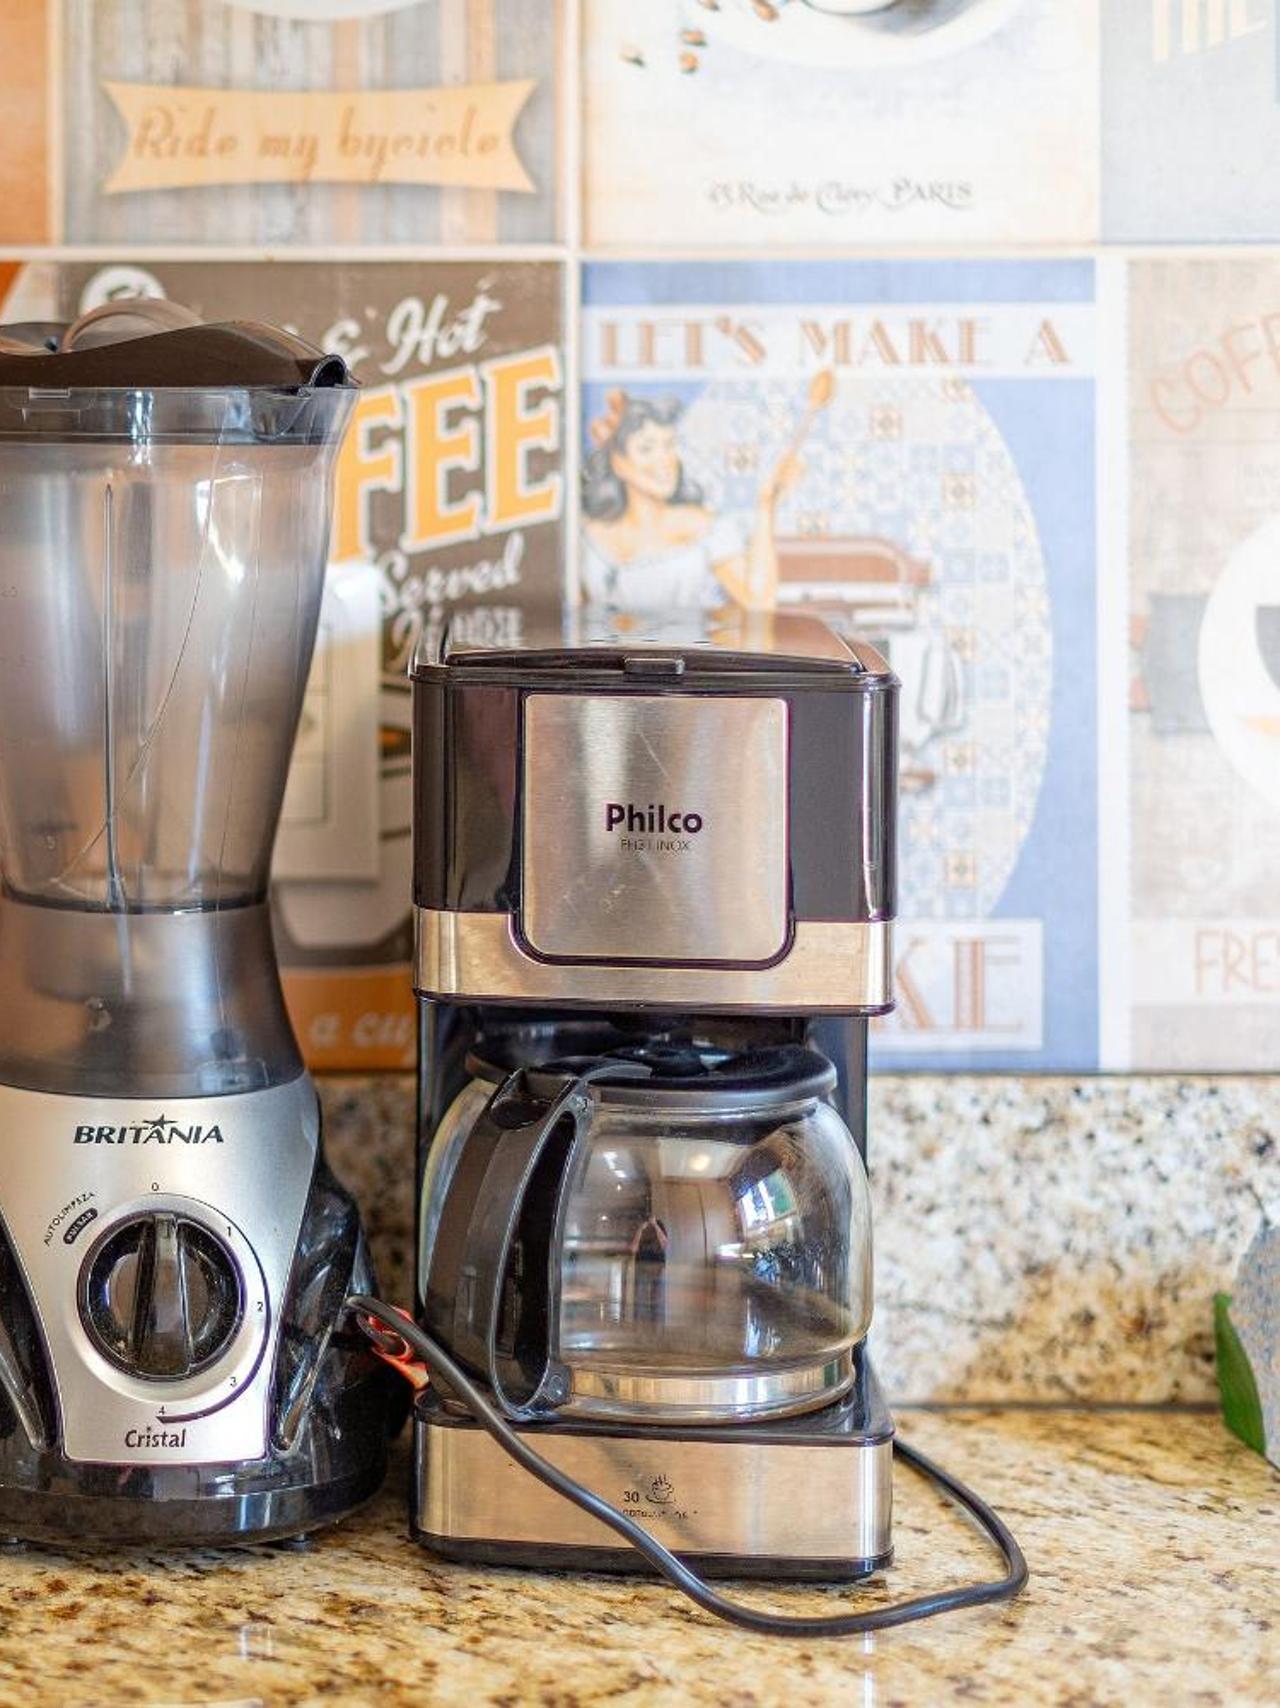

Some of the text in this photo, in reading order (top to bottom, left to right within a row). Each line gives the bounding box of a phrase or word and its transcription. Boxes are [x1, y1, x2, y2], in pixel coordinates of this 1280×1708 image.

[132, 104, 240, 161] Ride
[258, 132, 322, 187] my
[381, 284, 502, 374] Hot
[798, 317, 995, 367] MAKE
[1024, 318, 1072, 366] A
[330, 343, 564, 565] FEE
[606, 803, 703, 833] Philco
[352, 1011, 415, 1047] cu
[257, 1302, 264, 1312] 2
[230, 1377, 237, 1387] 3
[158, 1405, 166, 1415] 4
[125, 1426, 187, 1448] Cristal
[623, 1491, 640, 1503] 30
